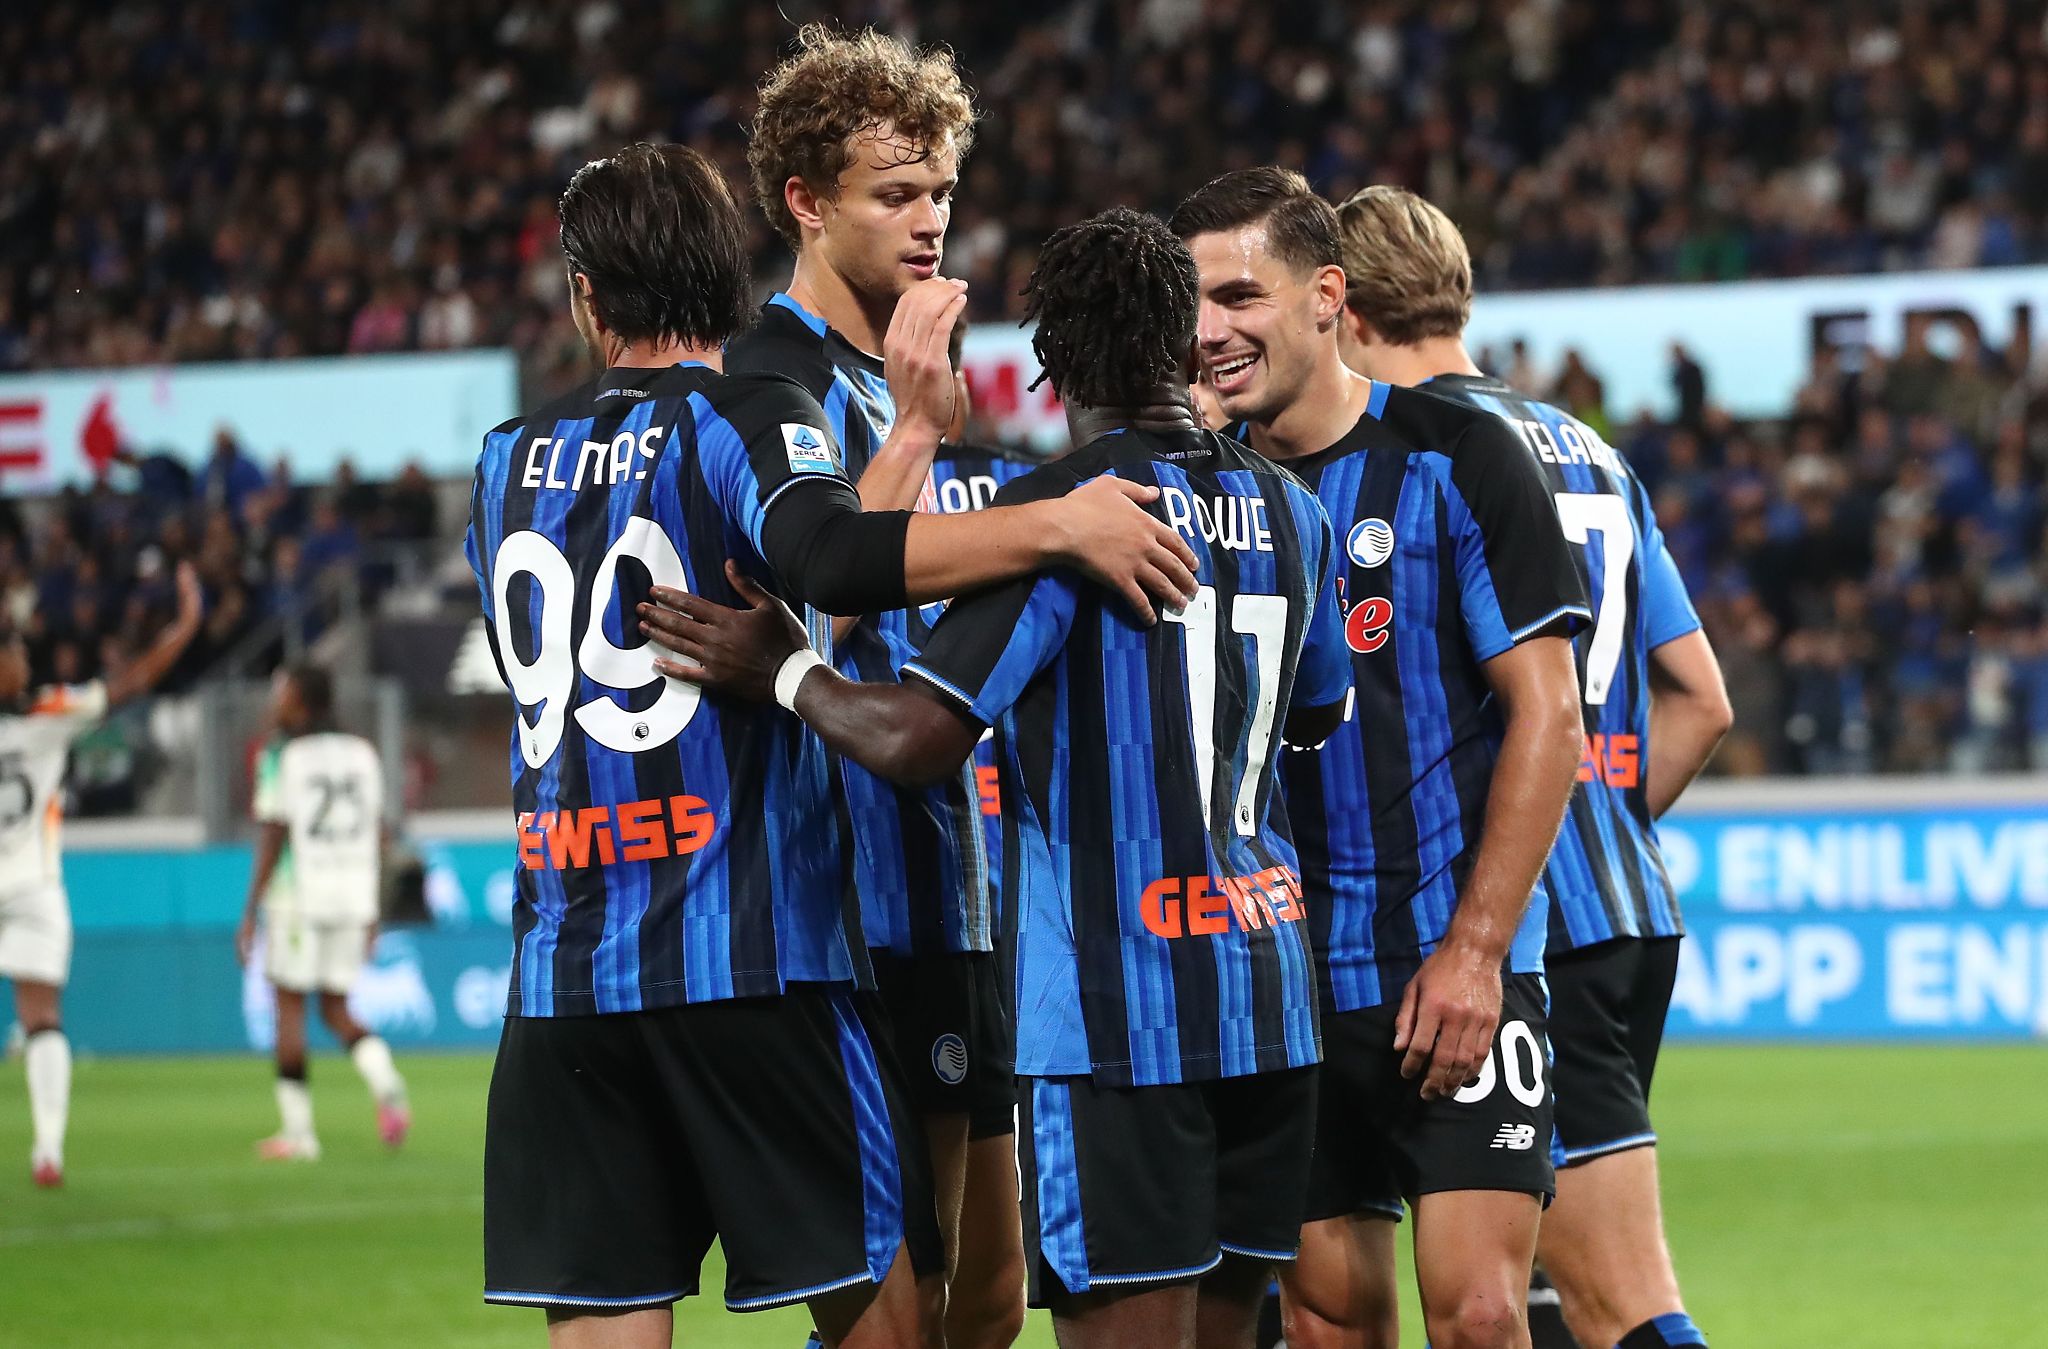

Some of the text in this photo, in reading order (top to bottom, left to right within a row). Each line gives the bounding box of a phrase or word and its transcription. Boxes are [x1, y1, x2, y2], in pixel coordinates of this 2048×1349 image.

[522, 427, 663, 491] ELMAS
[1162, 486, 1274, 551] ROWE
[493, 516, 702, 769] 99
[1162, 584, 1288, 837] 11
